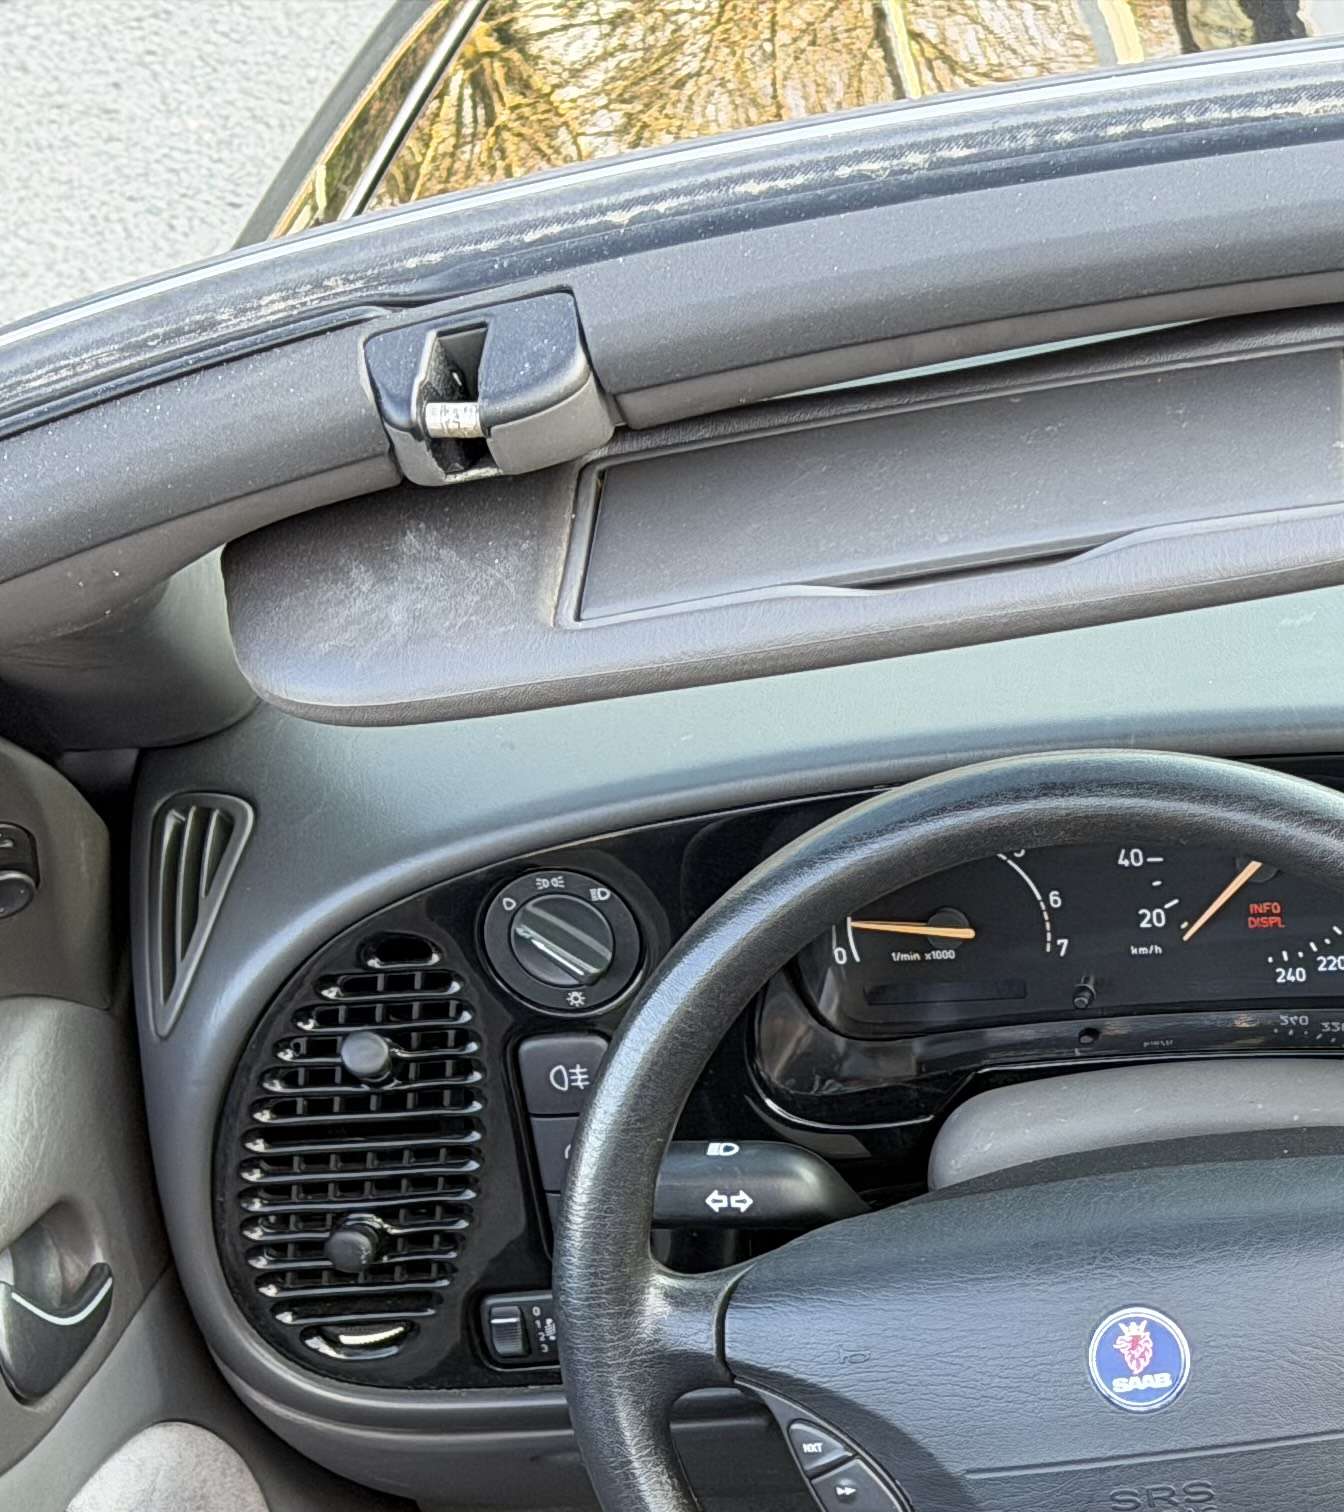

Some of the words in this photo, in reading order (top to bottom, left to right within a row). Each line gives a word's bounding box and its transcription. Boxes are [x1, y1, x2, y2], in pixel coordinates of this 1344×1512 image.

[1117, 848, 1144, 867] 40
[1049, 891, 1062, 908] 6
[1249, 902, 1281, 914] INFO
[1138, 908, 1166, 928] 20
[834, 947, 847, 965] 0
[891, 951, 921, 962] 1/min
[1057, 939, 1069, 957] 7
[1130, 945, 1162, 955] km/h
[1275, 967, 1307, 983] 240
[1112, 1372, 1173, 1393] SAAB
[1109, 1478, 1216, 1512] SRS
